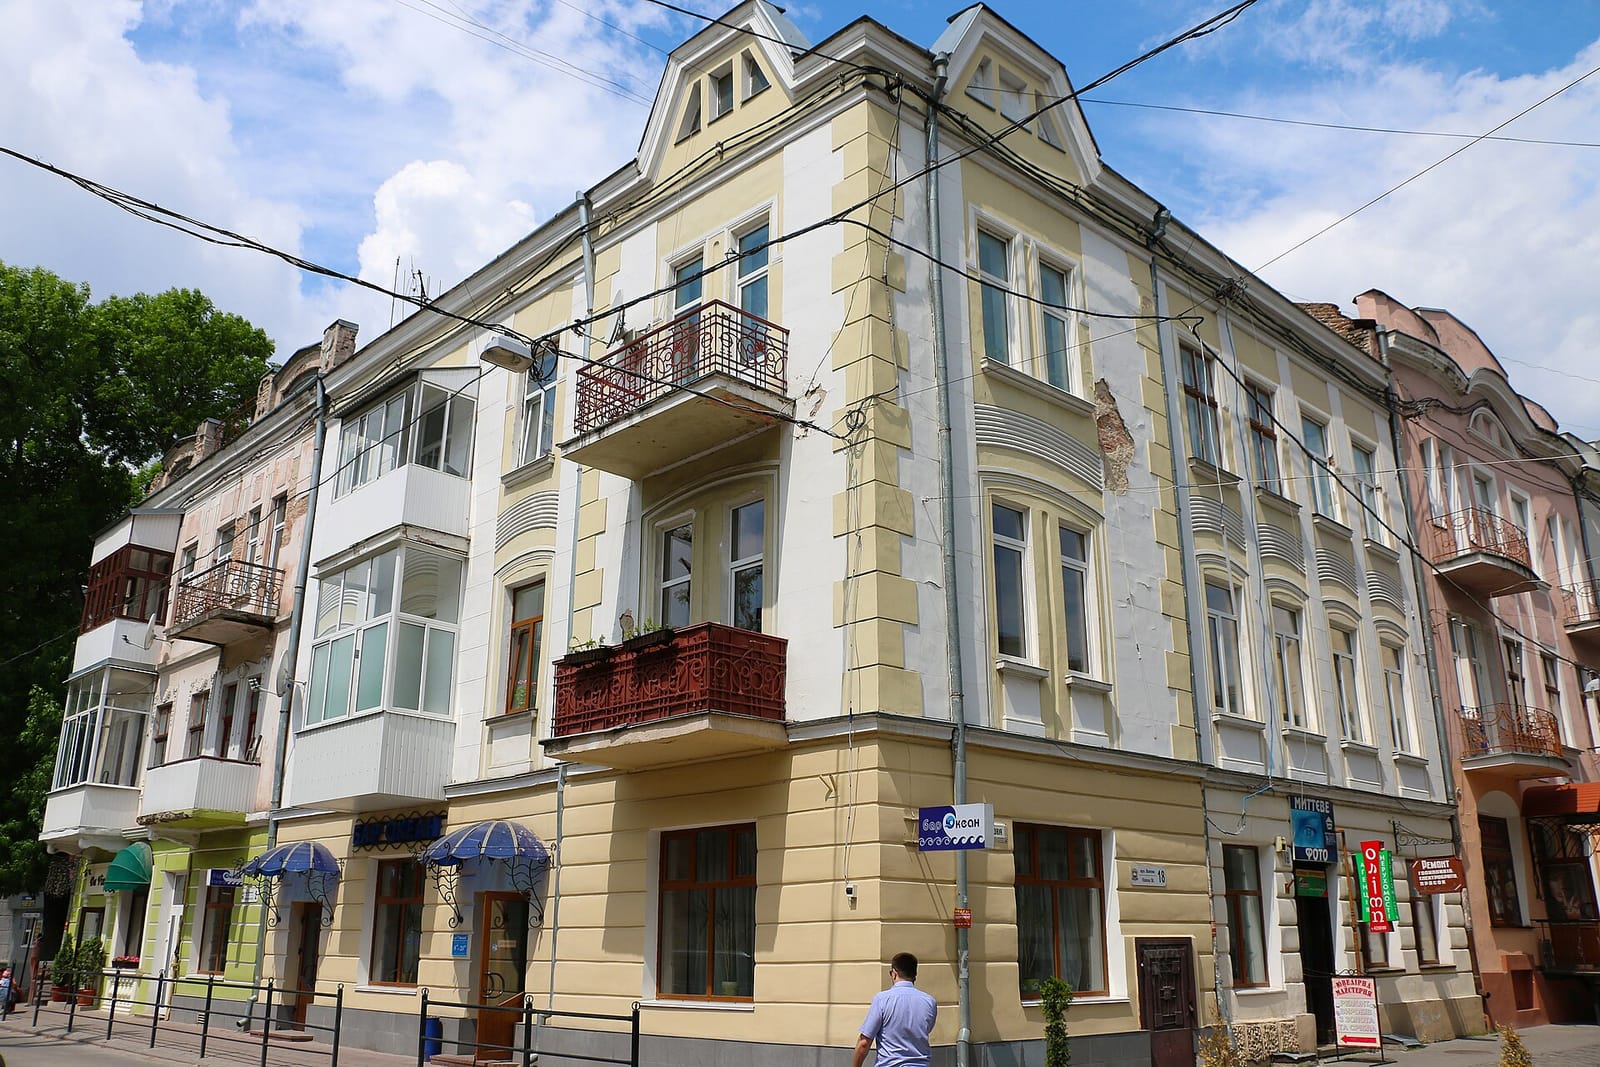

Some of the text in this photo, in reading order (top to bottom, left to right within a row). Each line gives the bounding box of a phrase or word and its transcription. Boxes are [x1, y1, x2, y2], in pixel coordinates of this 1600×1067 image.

[922, 819, 942, 834] бар
[1305, 848, 1329, 861] ФОТО
[1158, 869, 1165, 883] 18
